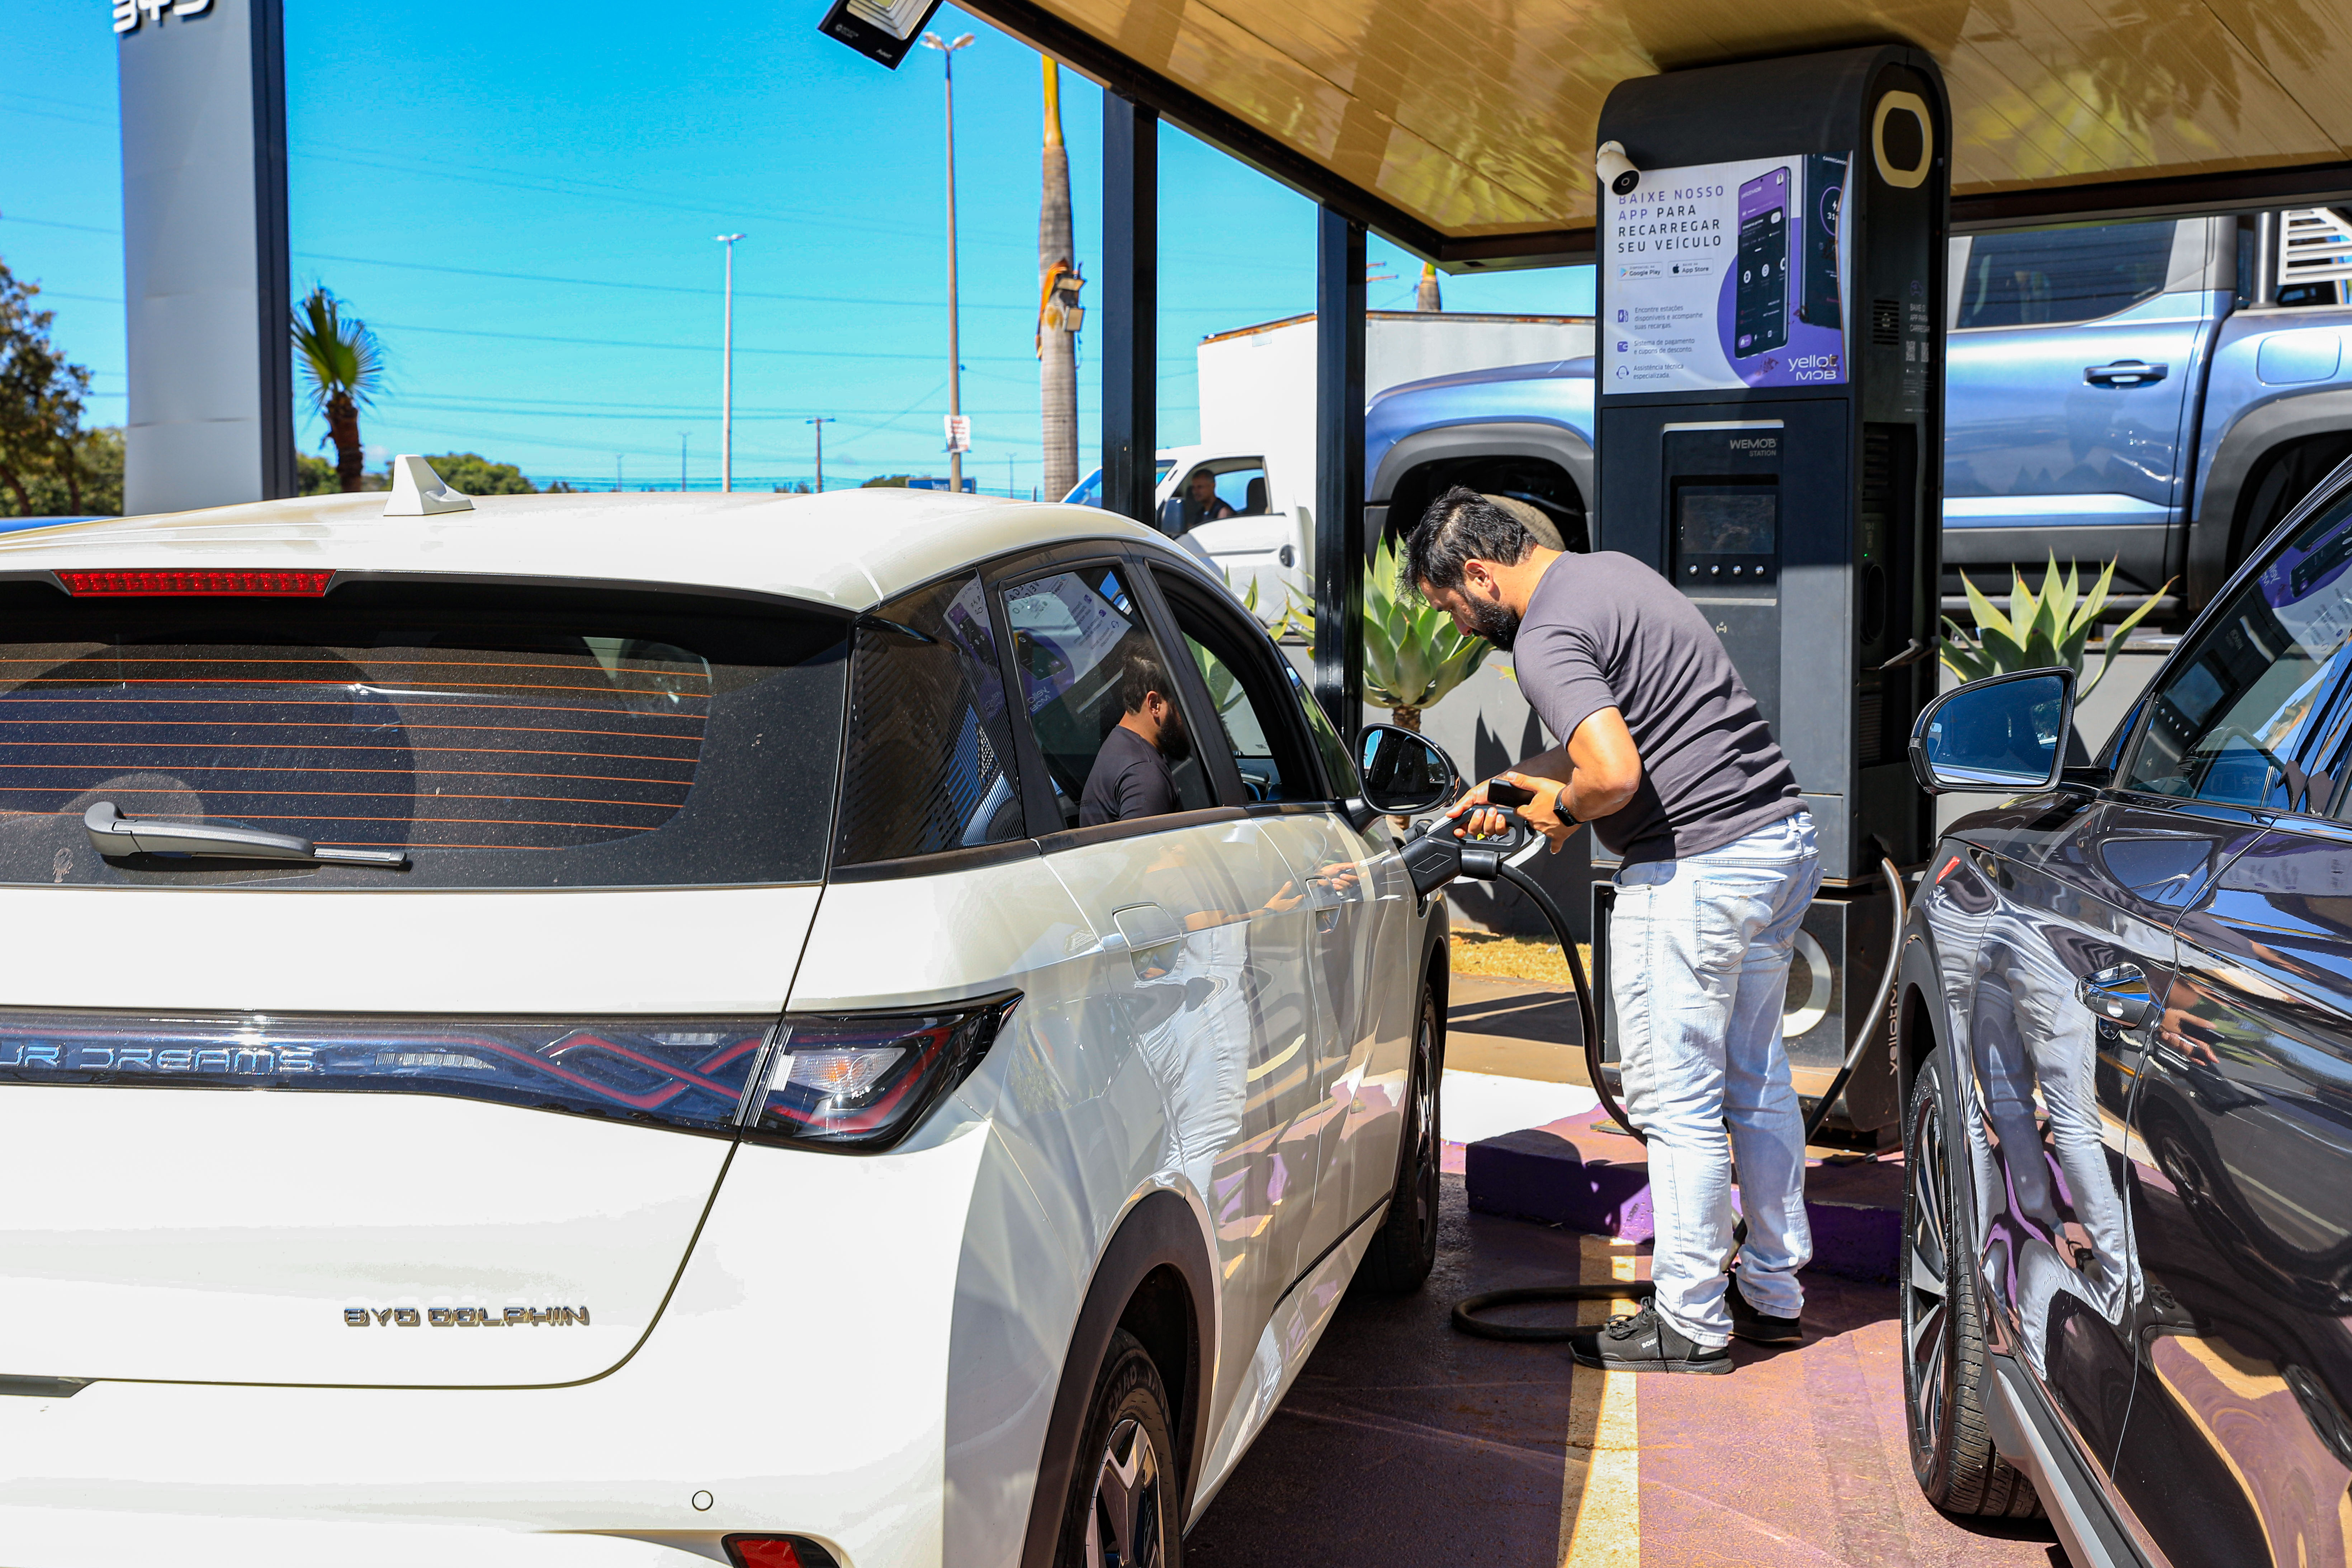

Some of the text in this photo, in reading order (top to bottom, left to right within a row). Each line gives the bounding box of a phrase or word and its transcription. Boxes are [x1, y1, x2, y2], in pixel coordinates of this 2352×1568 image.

[1619, 185, 1723, 205] BAIXE NOSSO
[1618, 205, 1696, 221] APP PARA
[1619, 219, 1719, 237] RECARREGAR
[1618, 235, 1721, 253] SEU VEÍCULO
[1788, 354, 1837, 372] yellot
[1796, 370, 1837, 381] MOB
[1730, 438, 1776, 449] WEMOB
[79, 1047, 314, 1072] DREAMS
[344, 1304, 590, 1327] BYD DOLPHIN
